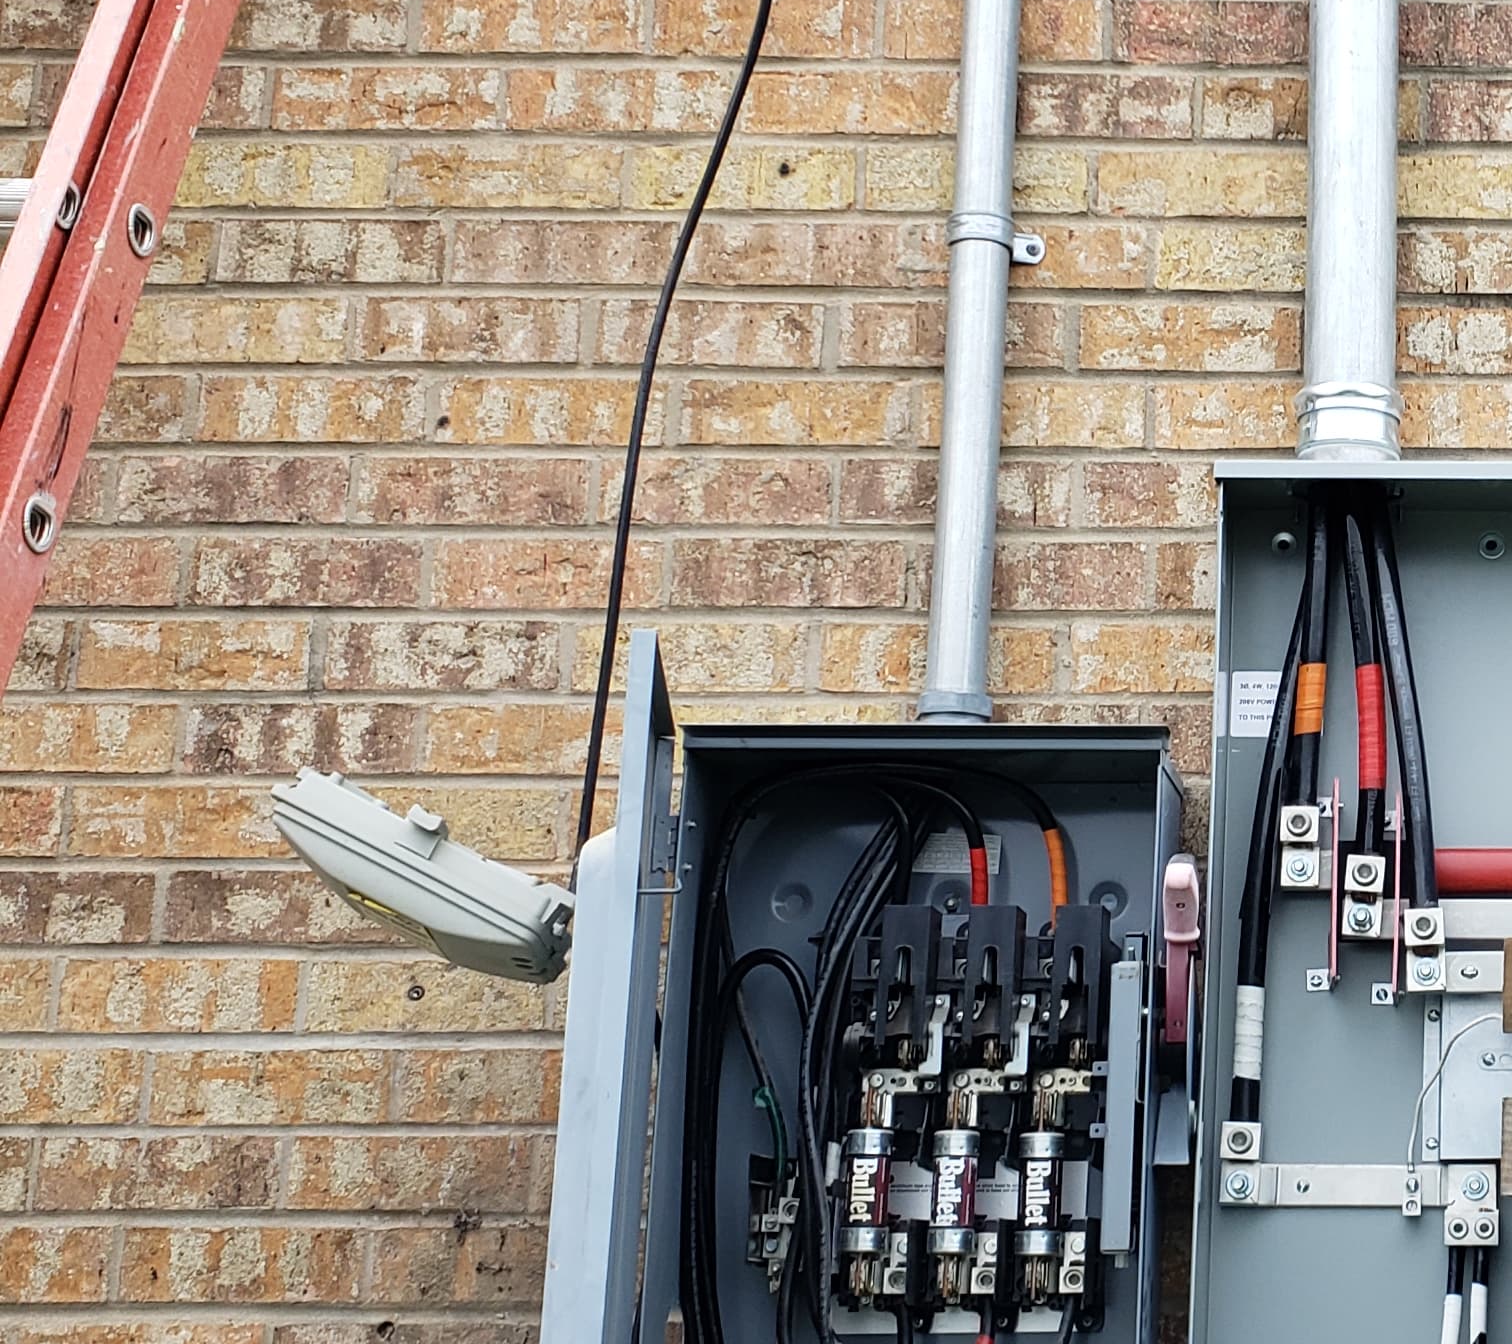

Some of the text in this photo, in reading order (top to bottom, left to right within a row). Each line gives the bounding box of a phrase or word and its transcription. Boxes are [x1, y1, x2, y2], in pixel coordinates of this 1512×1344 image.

[849, 1157, 878, 1223] Bullet
[936, 1157, 965, 1225] Bullet
[1024, 1160, 1052, 1227] Bullet
